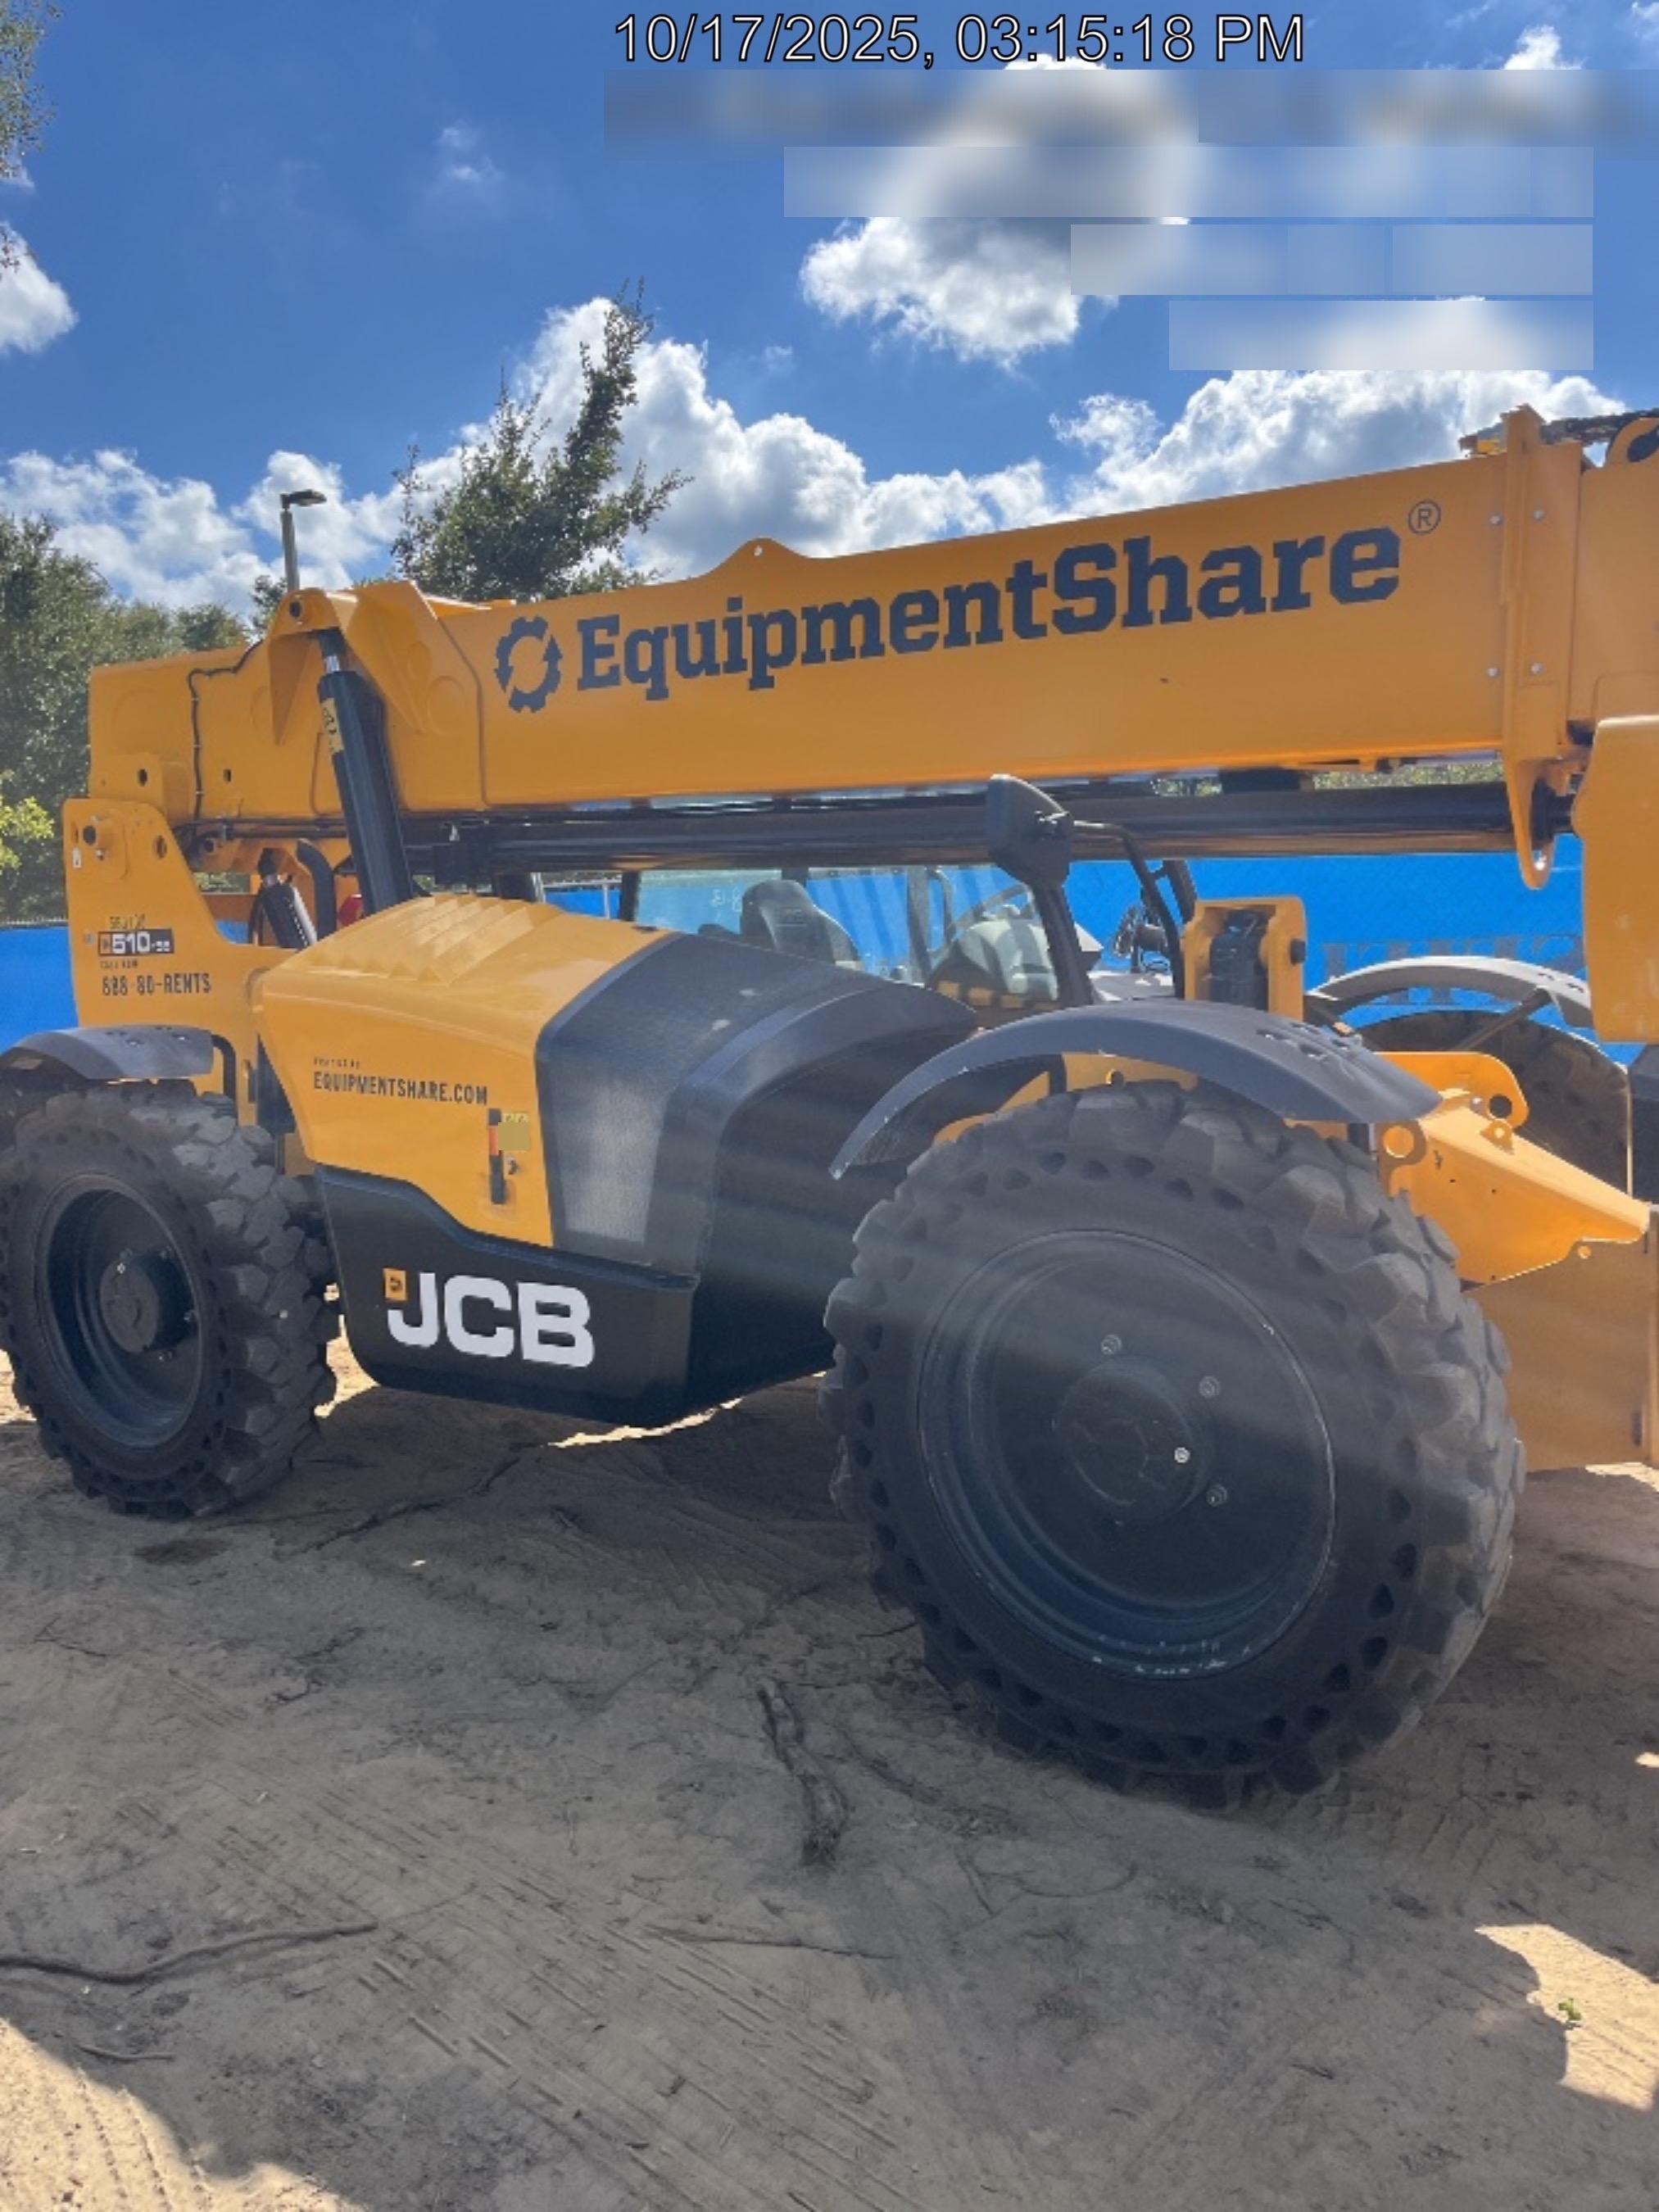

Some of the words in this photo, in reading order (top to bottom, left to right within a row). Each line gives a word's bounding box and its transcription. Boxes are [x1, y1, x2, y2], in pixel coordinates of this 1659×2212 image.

[577, 526, 1400, 700] EquipmentShare
[313, 1071, 487, 1105] EQUIPMENTSHARE.COM
[387, 1271, 596, 1369] JCB
